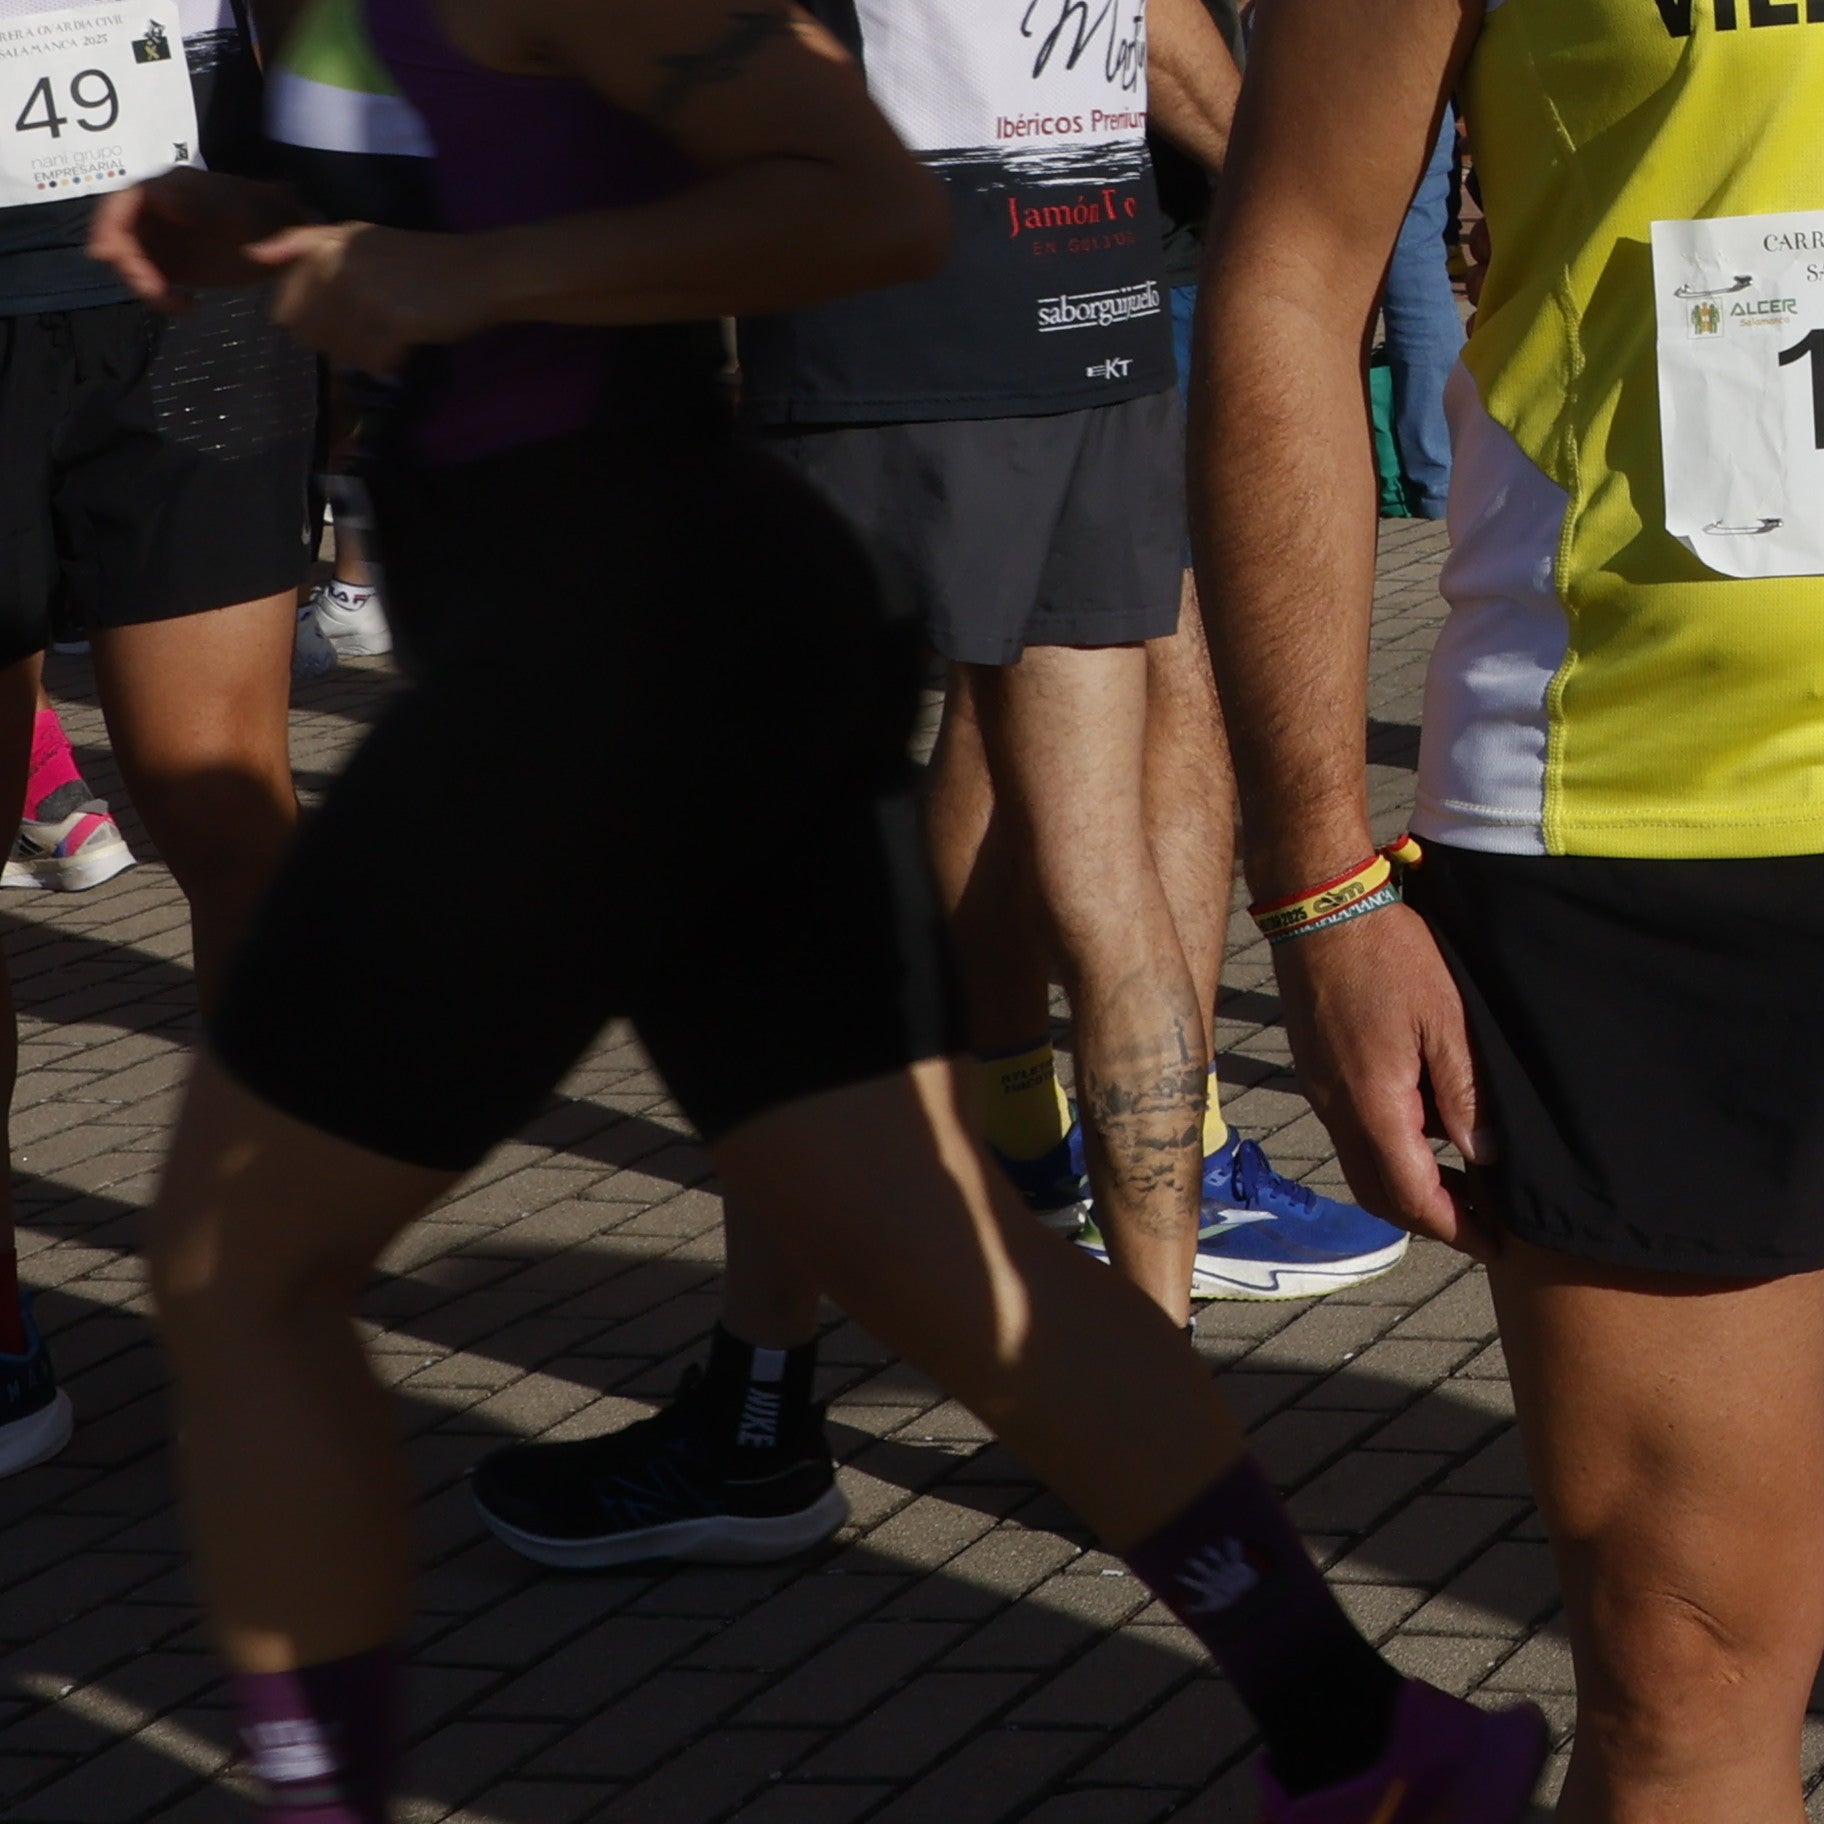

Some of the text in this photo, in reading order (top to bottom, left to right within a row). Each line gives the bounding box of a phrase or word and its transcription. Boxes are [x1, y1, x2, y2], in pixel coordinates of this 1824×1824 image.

[83, 34, 108, 46] 2025
[15, 68, 119, 139] 49
[997, 111, 1083, 139] Ibéricos
[73, 145, 123, 165] grupo
[34, 159, 125, 182] EMPRESARIAL
[1730, 298, 1798, 316] ALCER
[736, 1387, 781, 1448] NIKE
